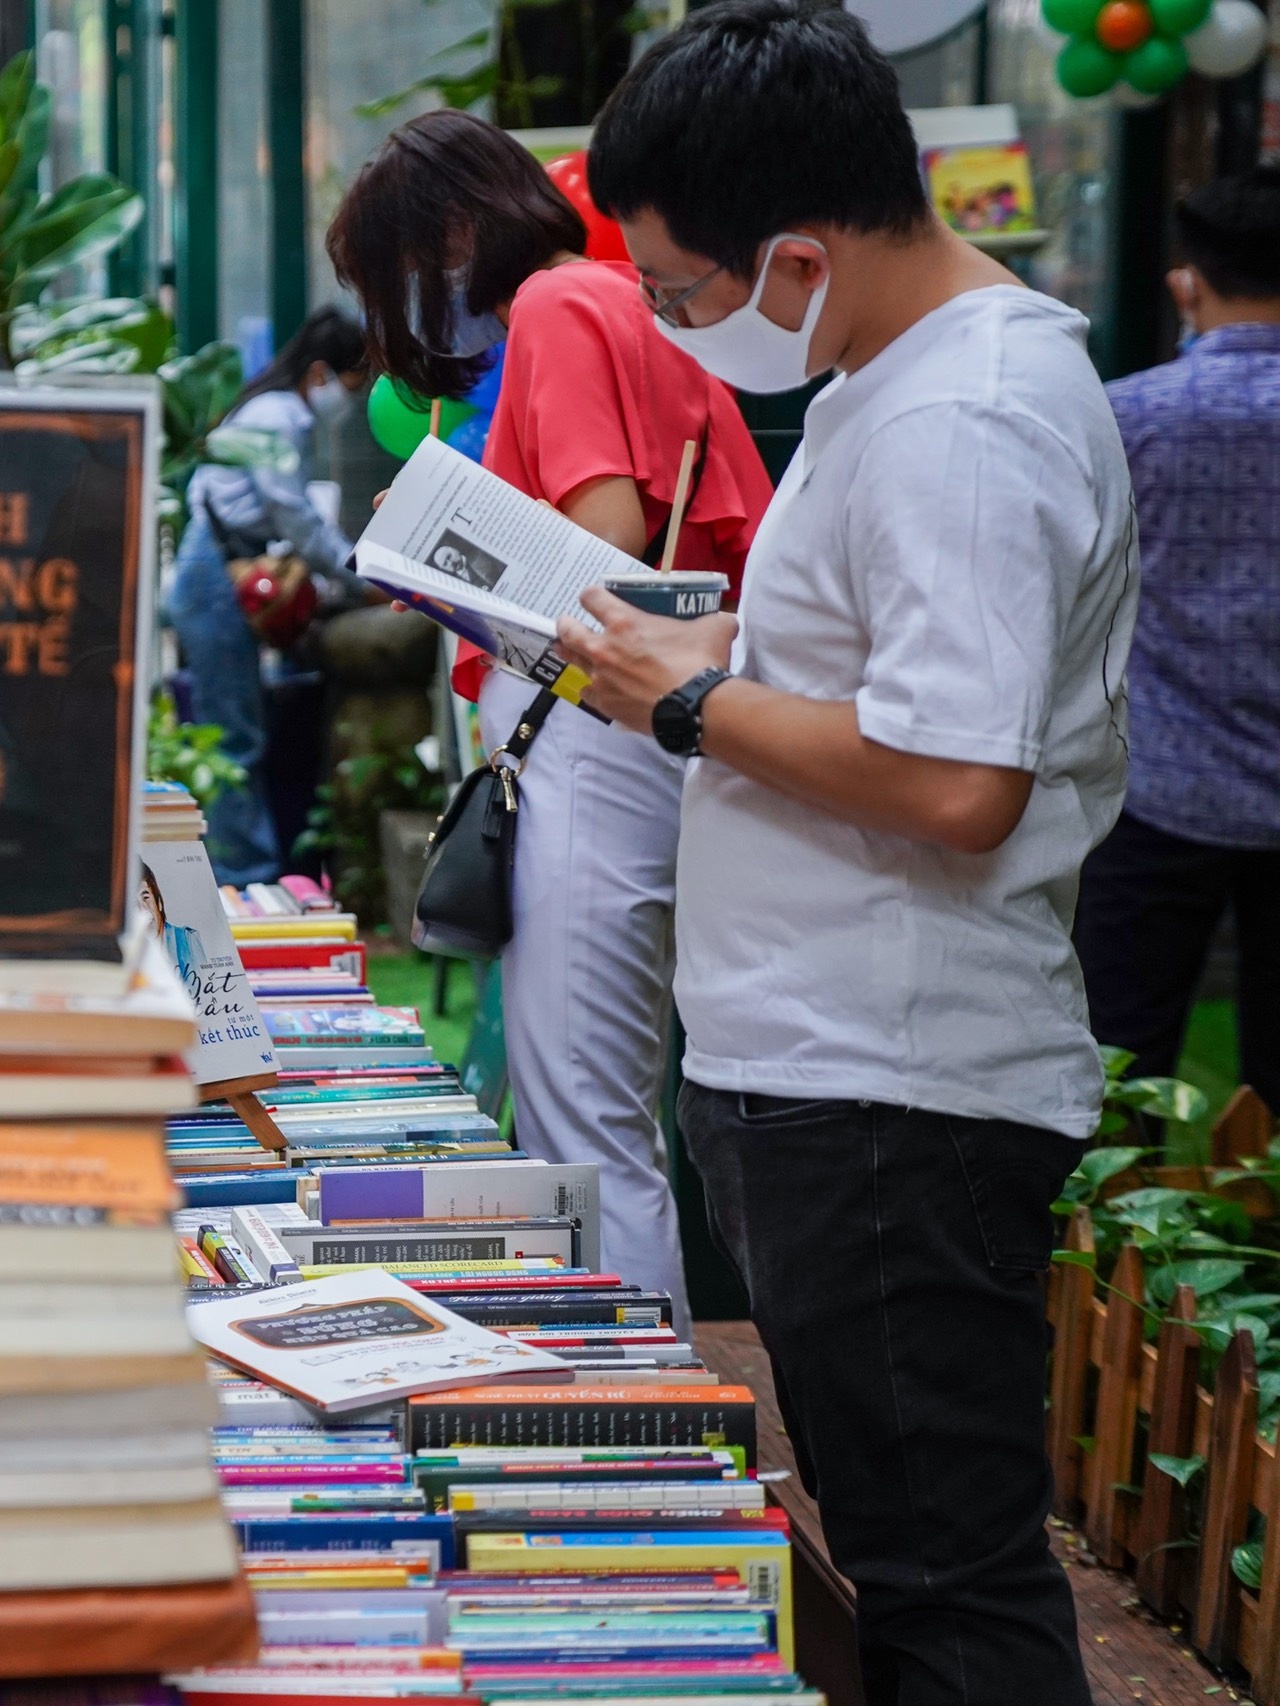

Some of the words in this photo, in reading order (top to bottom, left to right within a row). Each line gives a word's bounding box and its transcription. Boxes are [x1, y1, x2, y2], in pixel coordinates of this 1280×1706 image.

[175, 962, 246, 1000] Bắt
[199, 1028, 224, 1046] kết
[226, 1022, 261, 1041] thúc
[381, 1261, 435, 1271] BALANCED
[436, 1259, 503, 1269] SCORECARD
